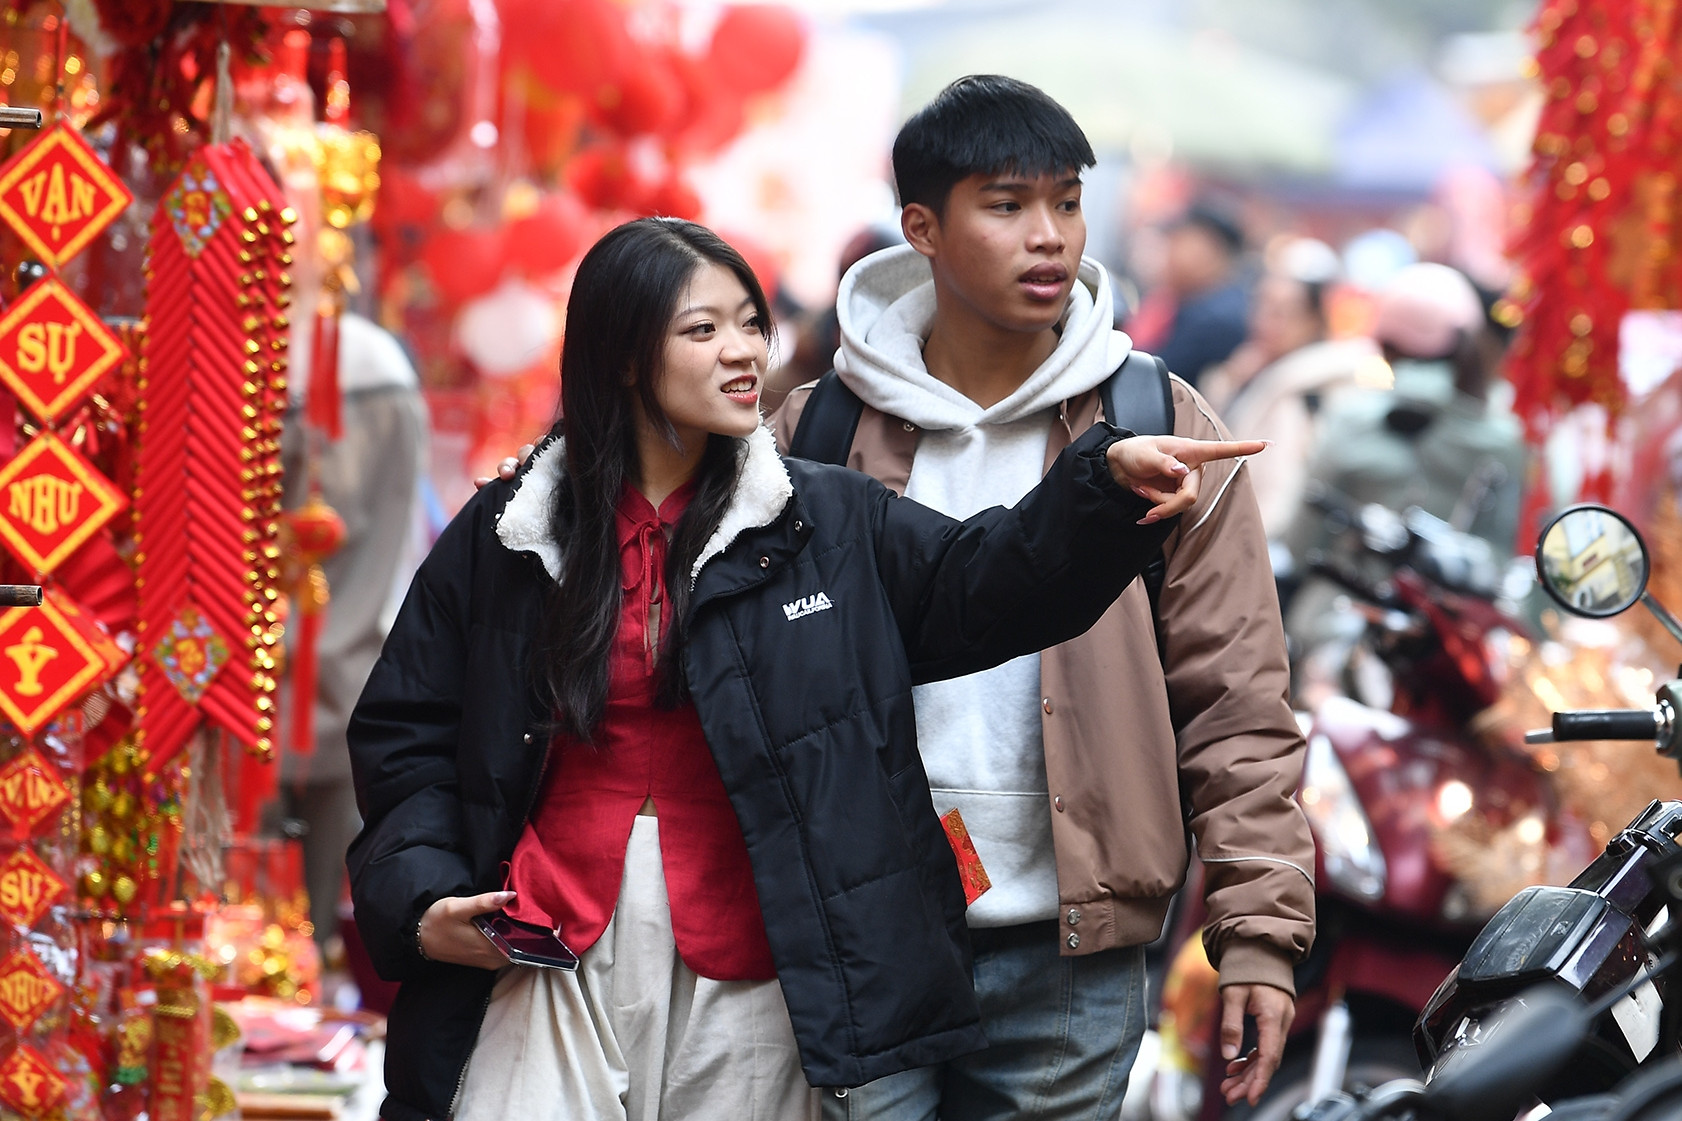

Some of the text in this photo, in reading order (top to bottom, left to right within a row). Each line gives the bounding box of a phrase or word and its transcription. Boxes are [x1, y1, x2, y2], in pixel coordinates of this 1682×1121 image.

[19, 161, 97, 242] VẠN
[16, 320, 83, 385] SỰ
[8, 473, 83, 535] NHƯ
[5, 626, 58, 697] Ý
